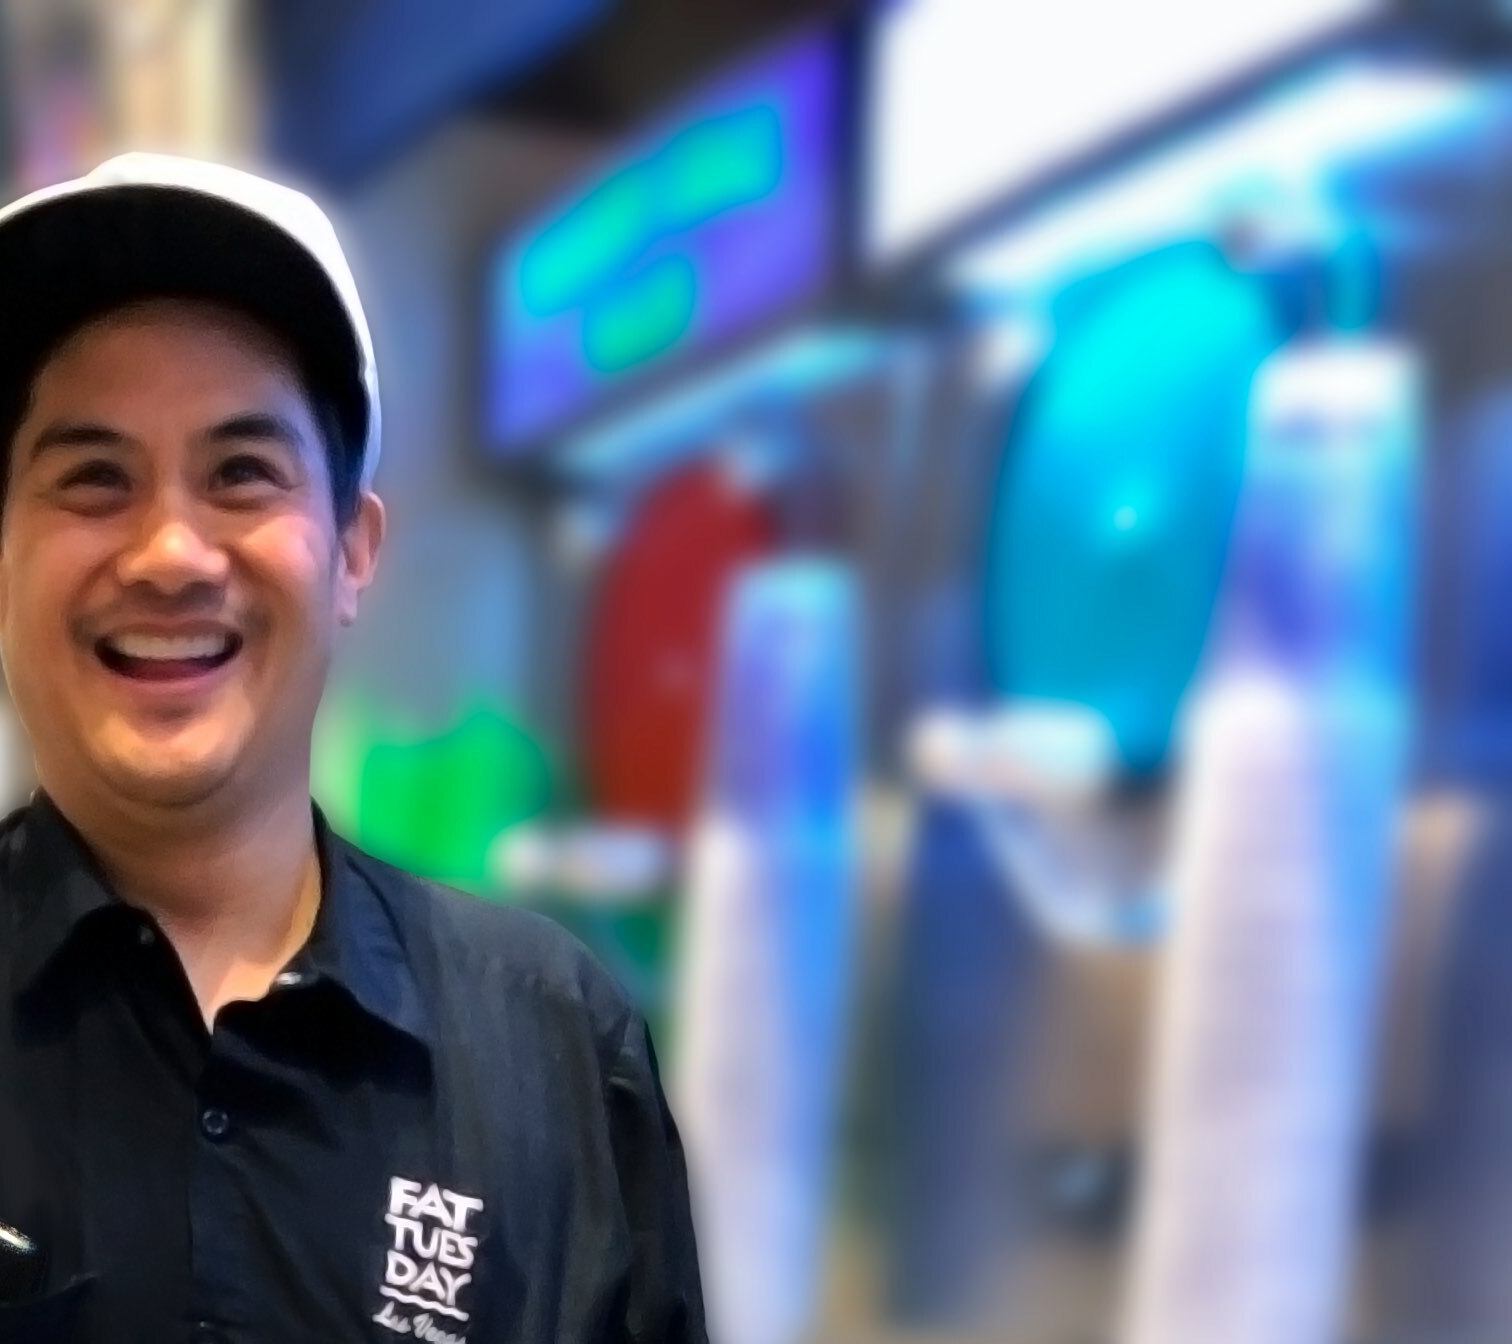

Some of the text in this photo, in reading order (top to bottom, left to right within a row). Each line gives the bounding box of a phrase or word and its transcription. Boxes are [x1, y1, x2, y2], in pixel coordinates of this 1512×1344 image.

[390, 1176, 484, 1232] FAT
[385, 1213, 478, 1269] TUES
[386, 1250, 472, 1306] DAY
